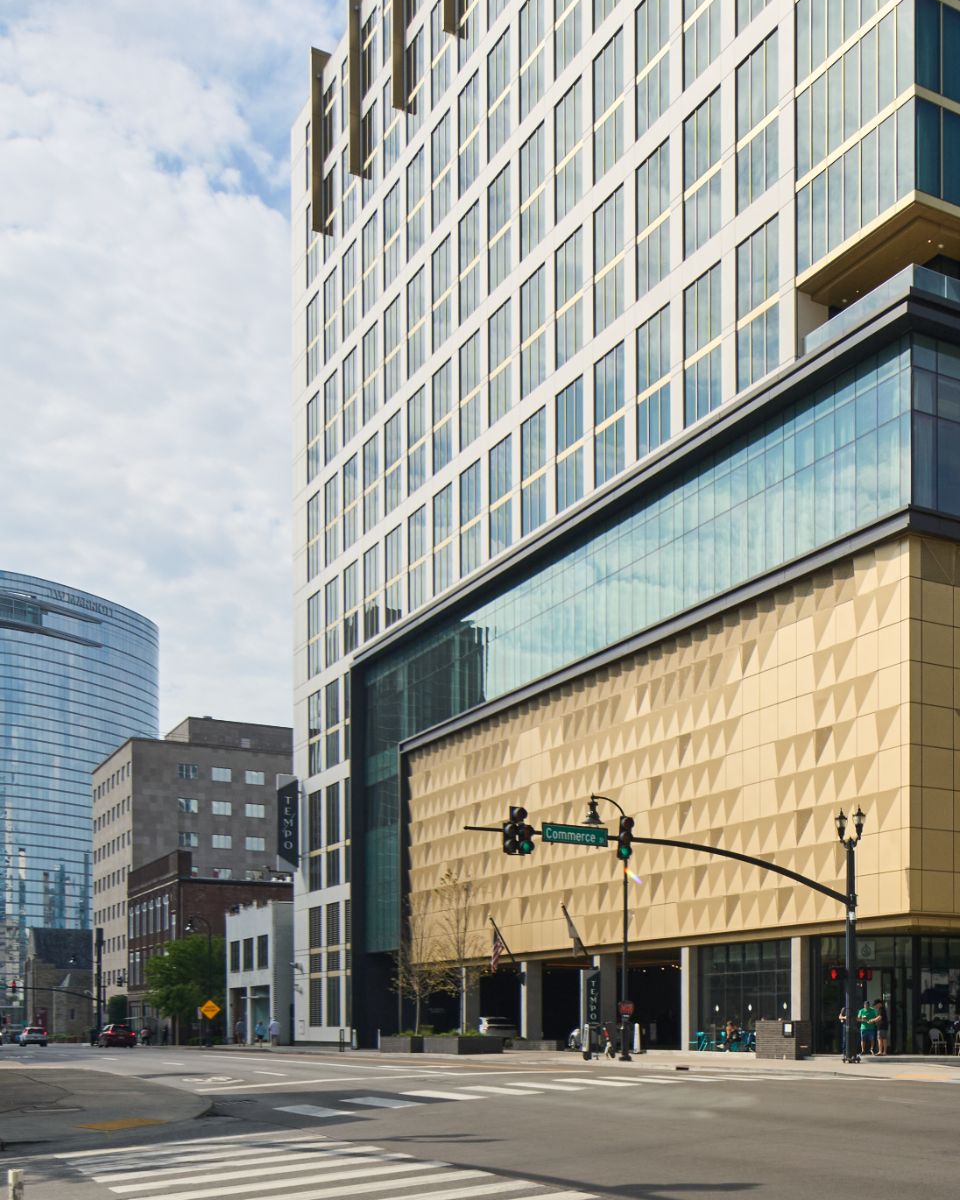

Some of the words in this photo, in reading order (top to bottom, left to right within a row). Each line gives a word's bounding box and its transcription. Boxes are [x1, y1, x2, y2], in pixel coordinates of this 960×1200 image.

[283, 796, 294, 850] TEMPO
[546, 827, 596, 843] Commerce
[590, 980, 598, 1020] TEMPO
